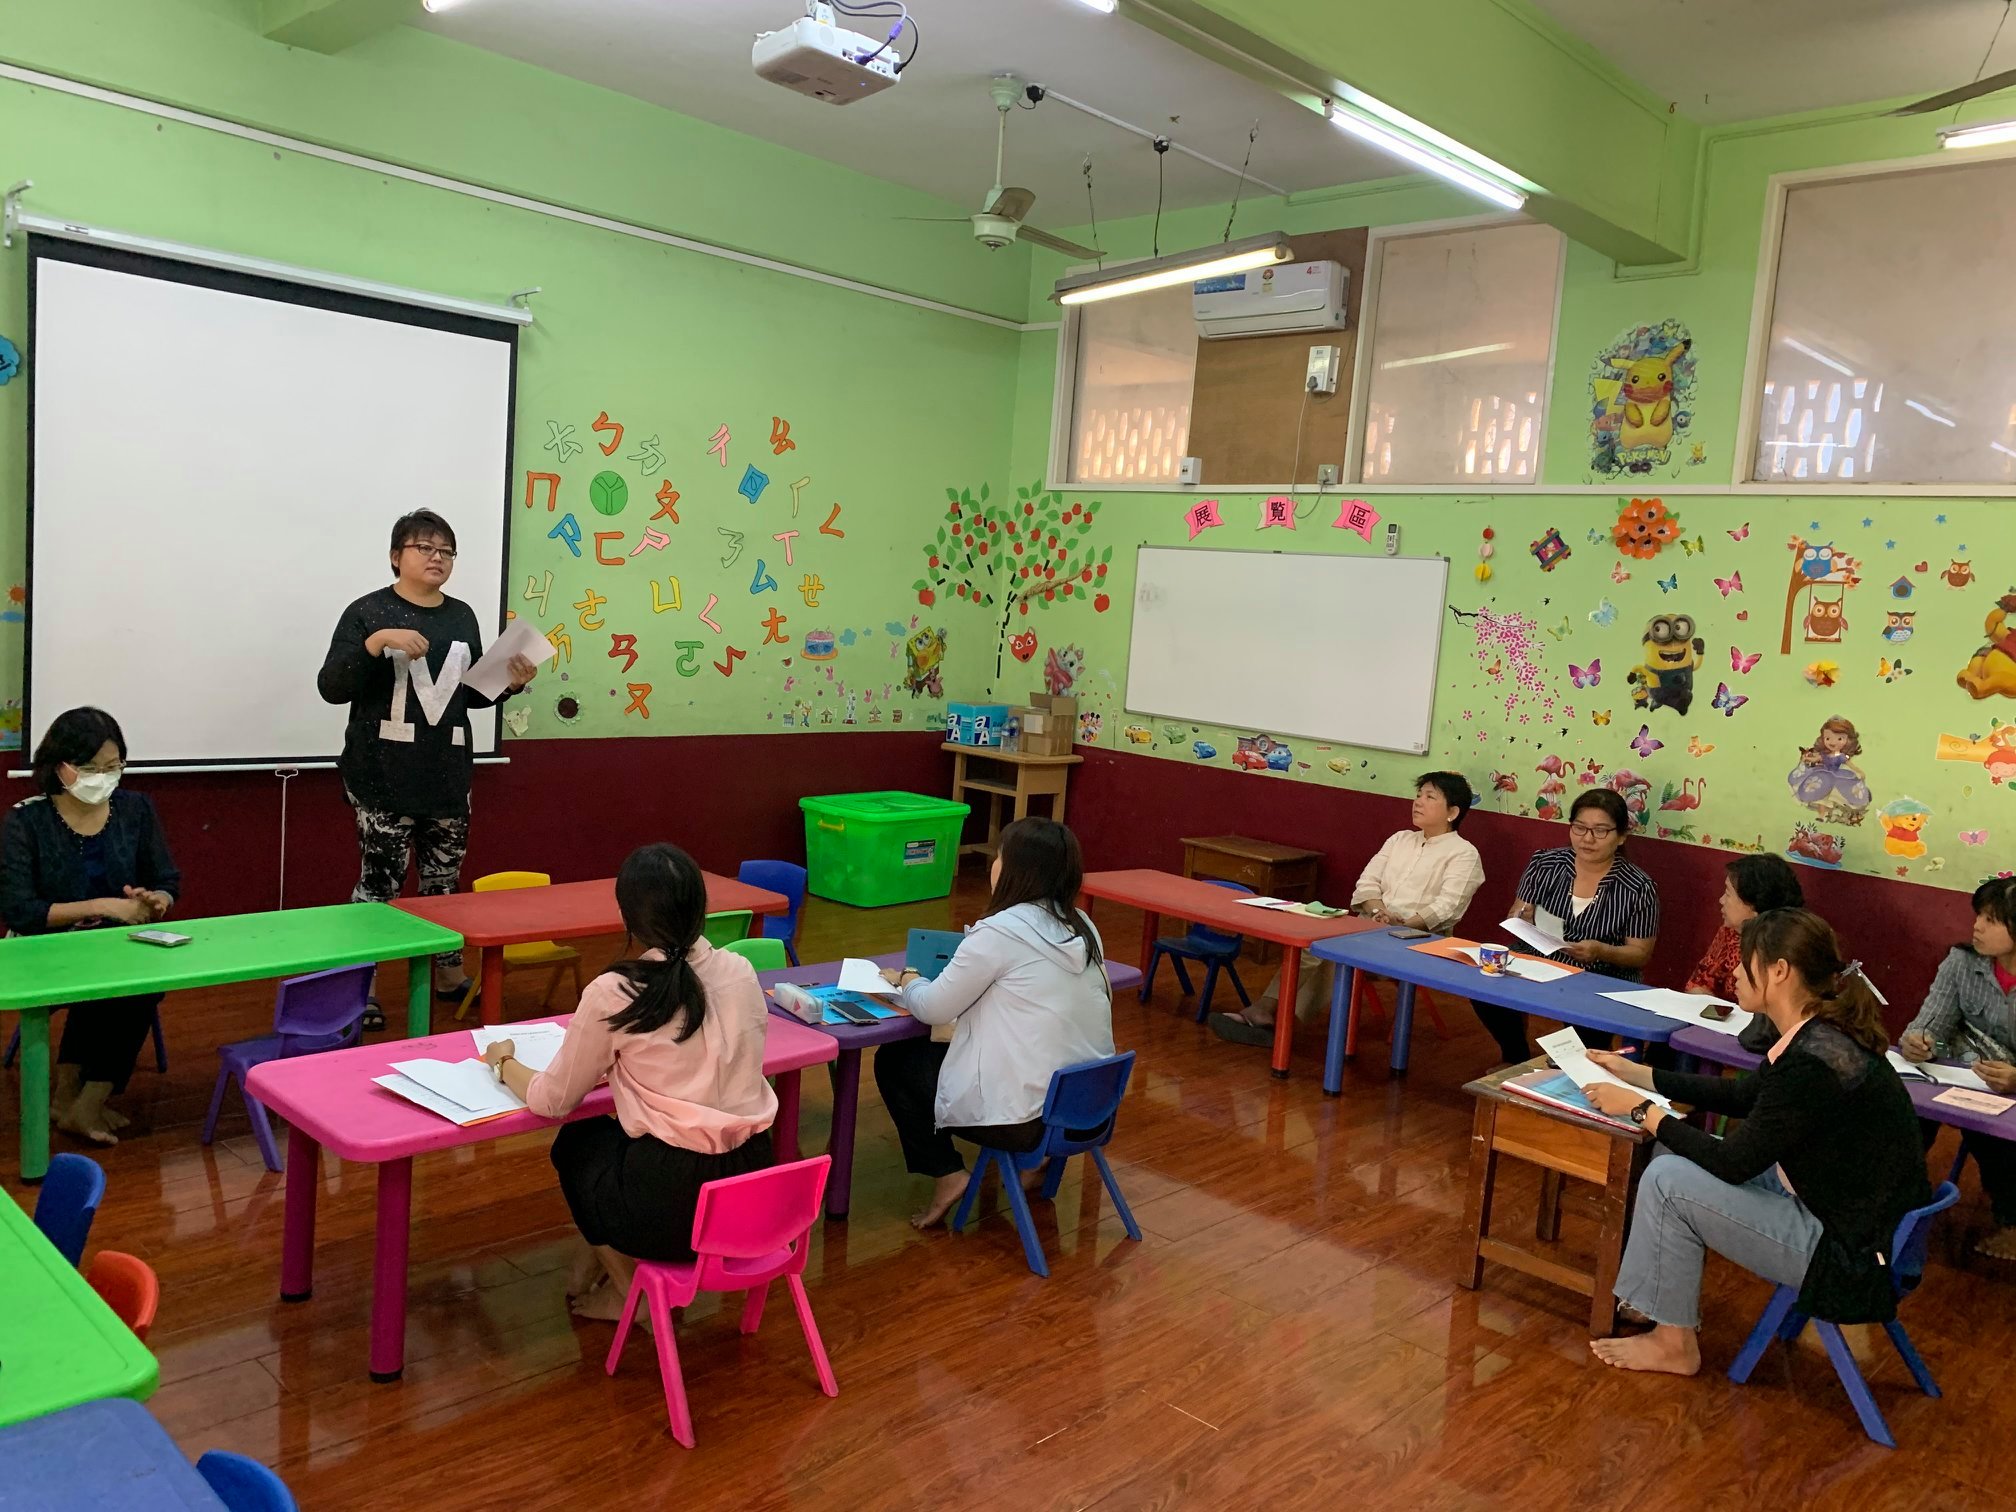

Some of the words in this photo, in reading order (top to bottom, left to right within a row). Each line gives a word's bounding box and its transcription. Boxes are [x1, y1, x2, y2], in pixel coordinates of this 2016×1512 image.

[592, 411, 624, 456] ㄅ
[1195, 505, 1212, 527] 展
[1349, 504, 1371, 529] 區
[379, 641, 473, 746] M
